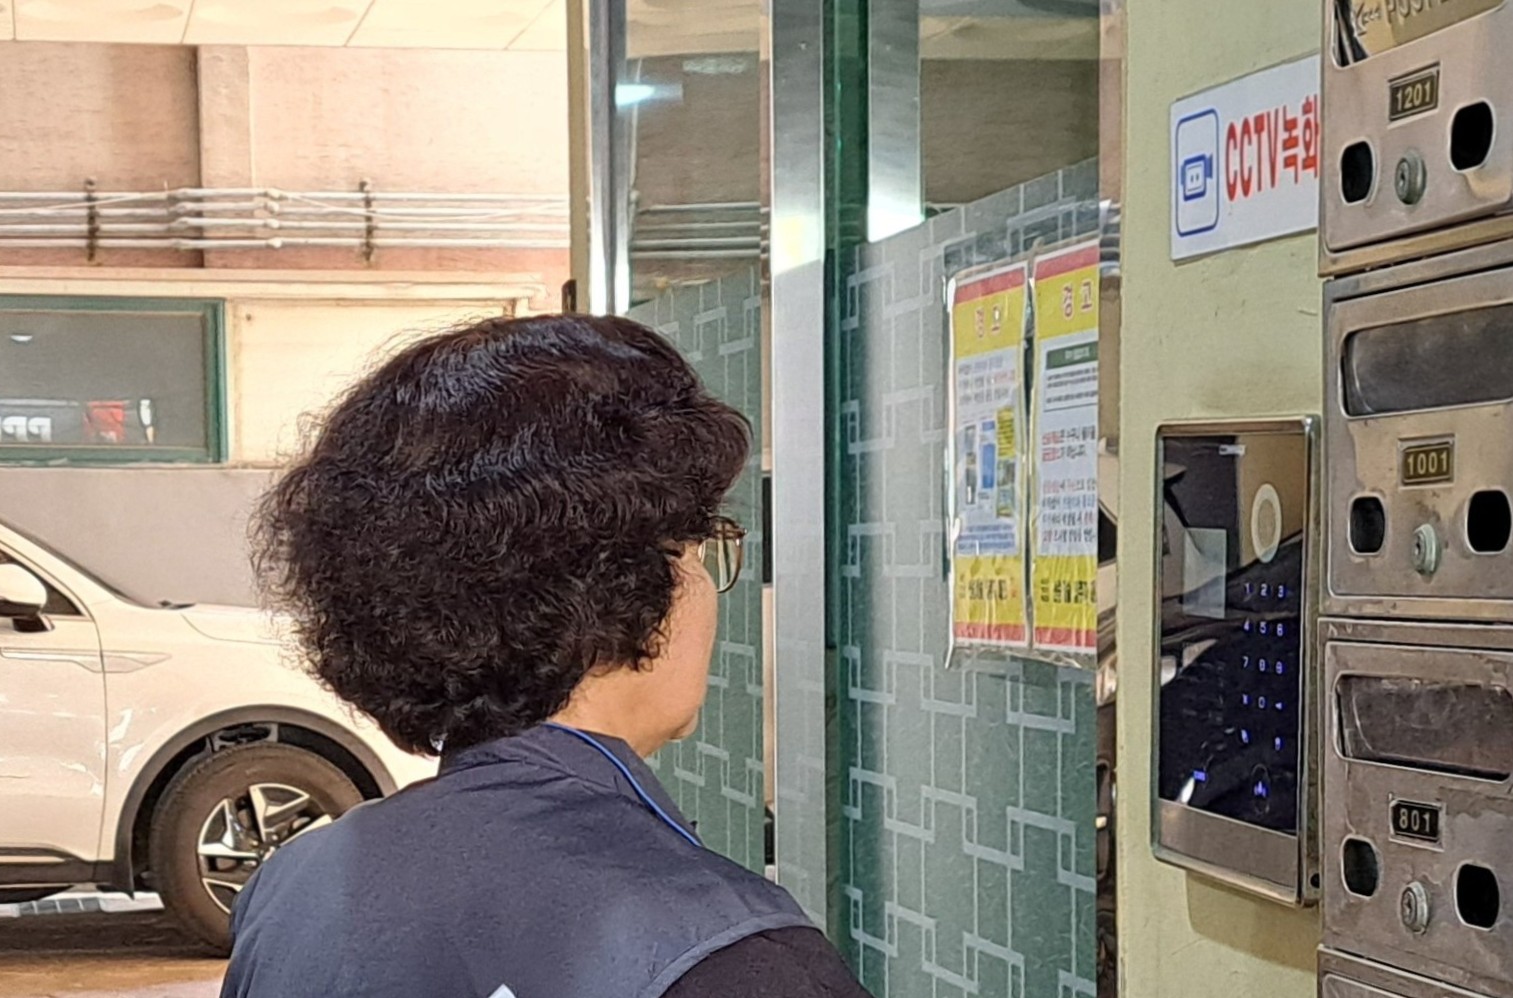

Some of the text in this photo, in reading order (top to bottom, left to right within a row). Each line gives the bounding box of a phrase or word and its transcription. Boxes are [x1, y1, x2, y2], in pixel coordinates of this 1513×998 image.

[1396, 80, 1432, 112] 1201
[1407, 450, 1448, 476] 1001
[1398, 808, 1430, 833] 801
